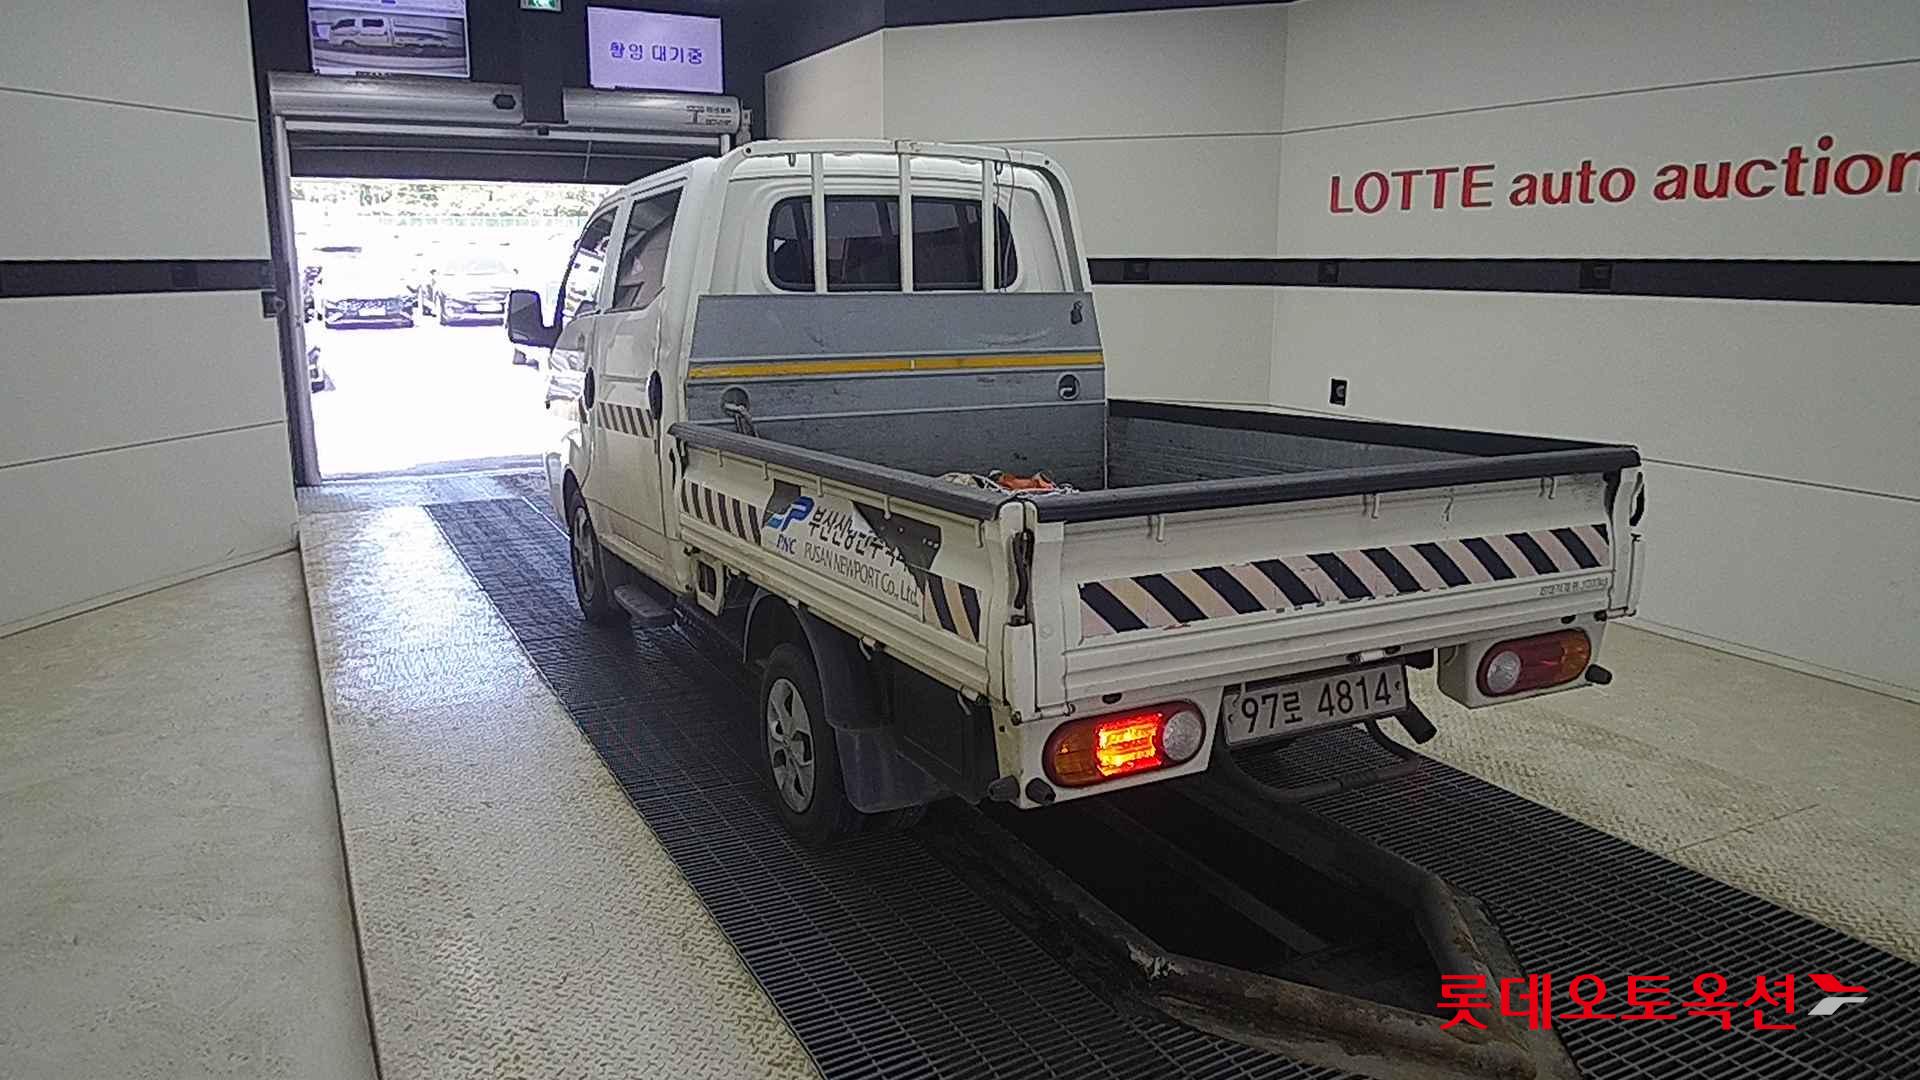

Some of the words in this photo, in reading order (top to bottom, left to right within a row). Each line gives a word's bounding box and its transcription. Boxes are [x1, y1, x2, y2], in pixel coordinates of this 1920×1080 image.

[1329, 163, 1496, 214] LOTTE
[1508, 160, 1636, 206] auto
[1241, 691, 1303, 734] 97로
[1317, 671, 1392, 717] 4814
